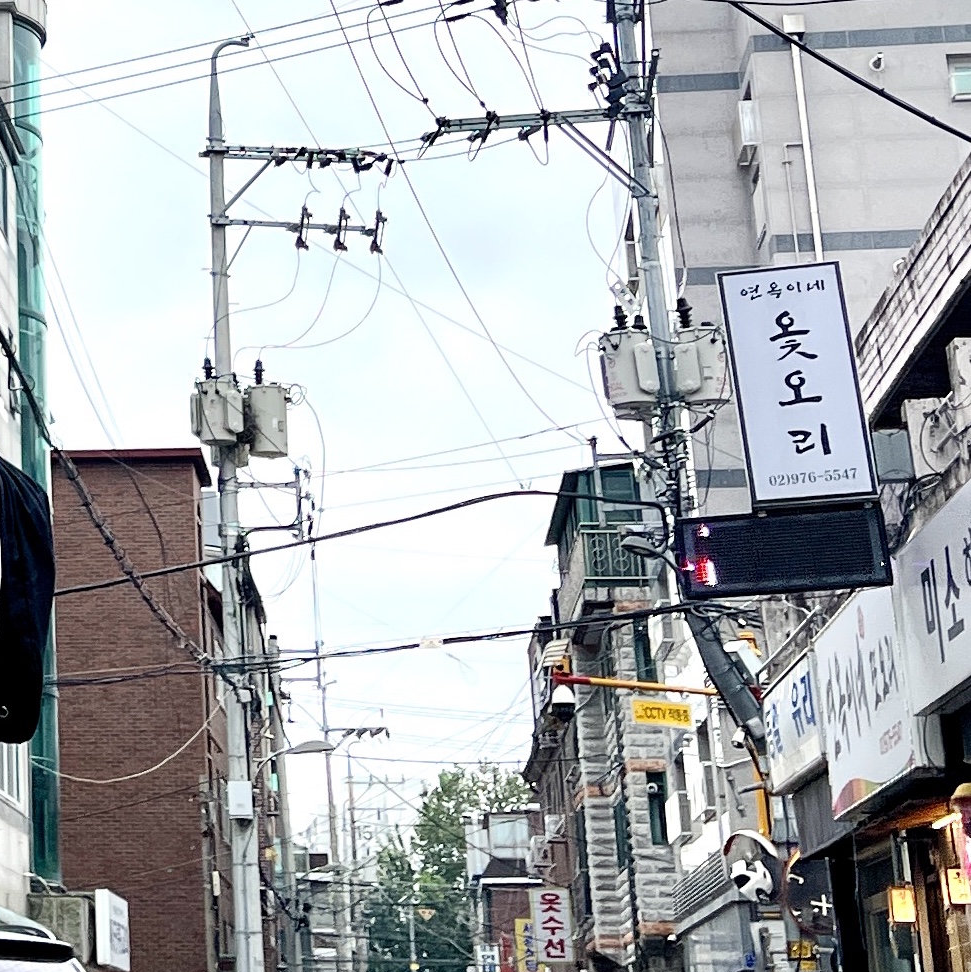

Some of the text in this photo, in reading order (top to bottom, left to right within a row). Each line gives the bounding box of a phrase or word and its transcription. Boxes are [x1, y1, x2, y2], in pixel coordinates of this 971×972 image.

[768, 467, 858, 487] 02)976-5547
[644, 706, 666, 719] CCTV
[792, 671, 817, 738] 유리
